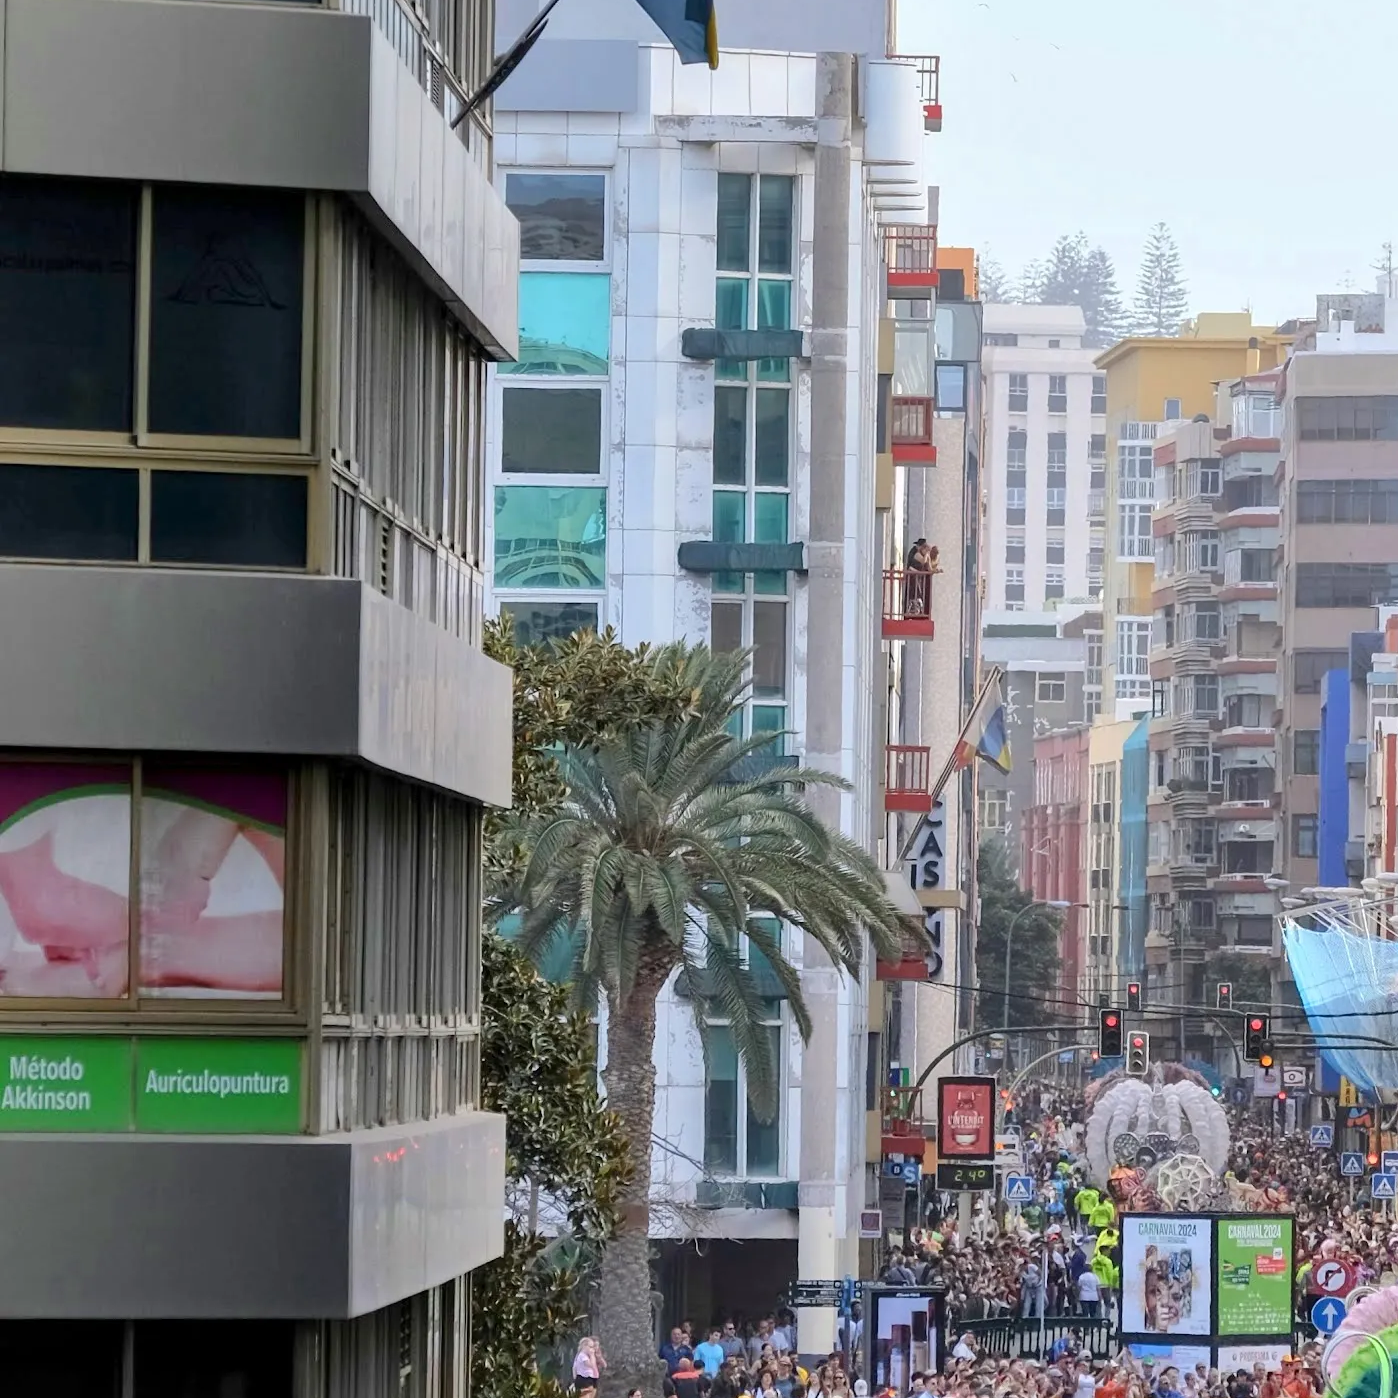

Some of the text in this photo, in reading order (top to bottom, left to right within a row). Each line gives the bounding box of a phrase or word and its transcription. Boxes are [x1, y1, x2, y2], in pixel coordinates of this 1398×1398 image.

[920, 799, 944, 979] CASNO
[9, 1056, 84, 1081] Método
[145, 1069, 290, 1098] Auriculopuntura
[1, 1085, 91, 1111] Akkinson
